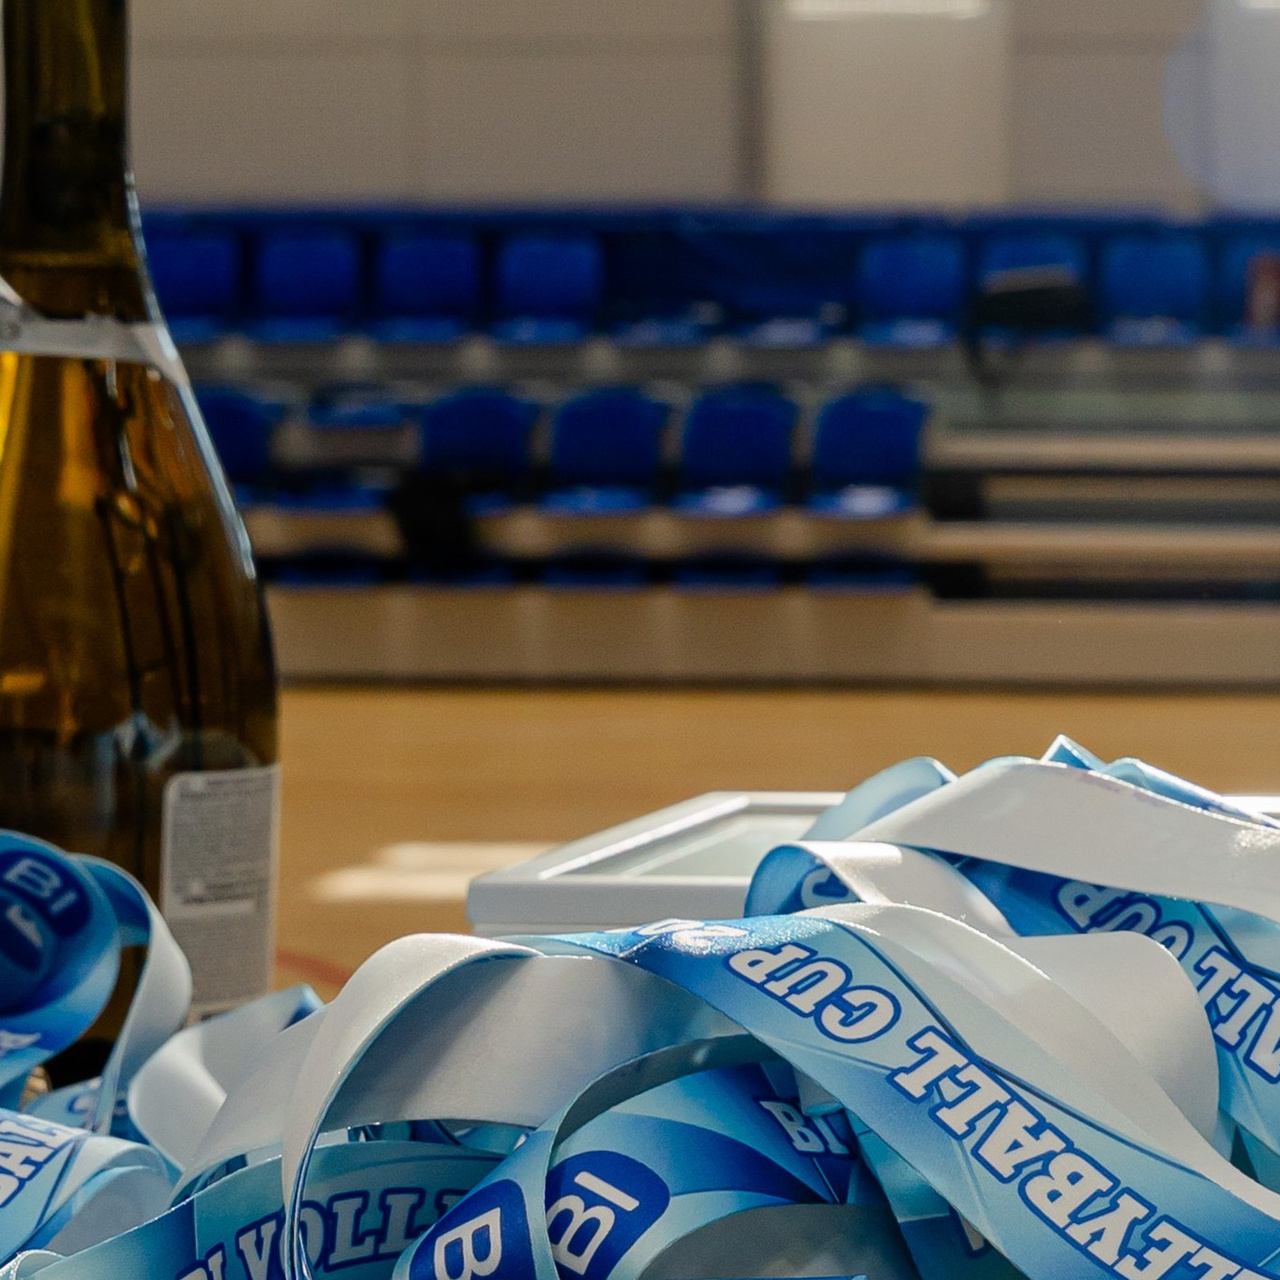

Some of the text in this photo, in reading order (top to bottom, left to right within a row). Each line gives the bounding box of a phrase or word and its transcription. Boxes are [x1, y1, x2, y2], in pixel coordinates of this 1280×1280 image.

[4, 858, 77, 915] BI
[728, 944, 896, 1041] CUP
[759, 1100, 850, 1155] BI
[546, 1170, 640, 1276] BI
